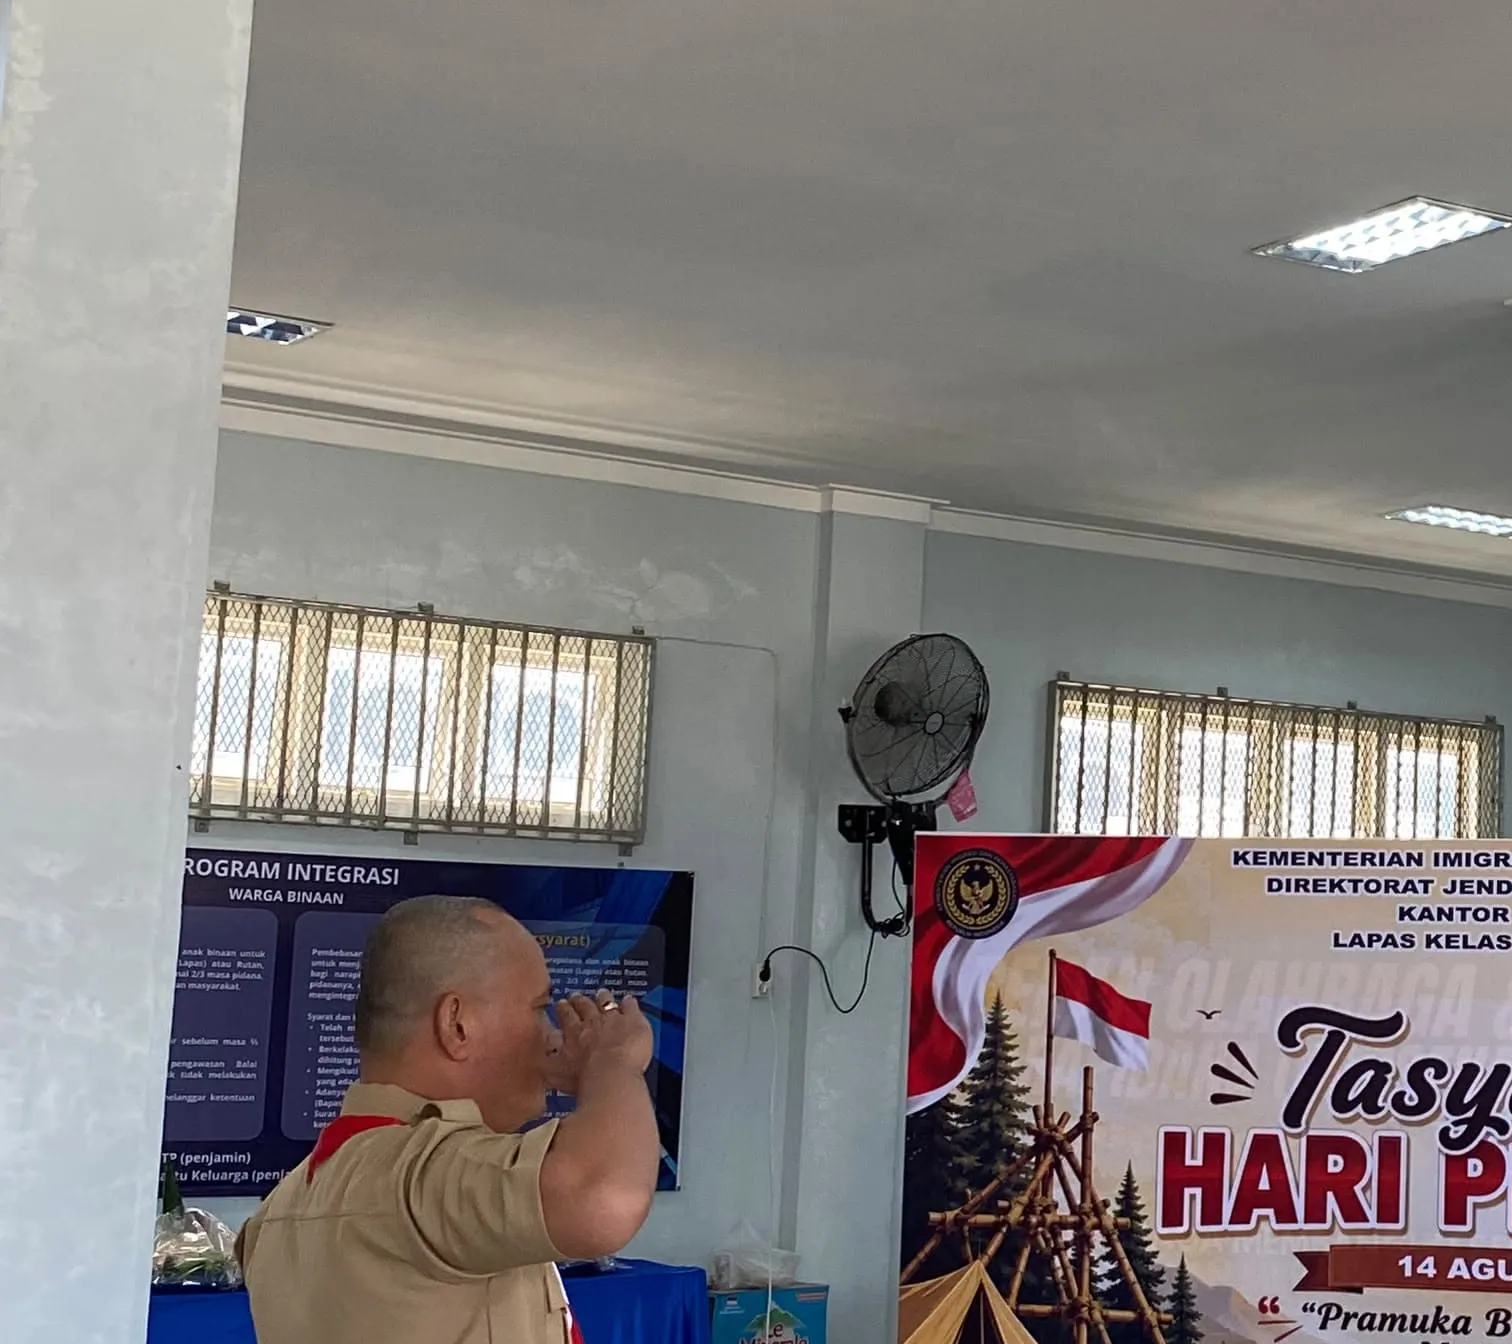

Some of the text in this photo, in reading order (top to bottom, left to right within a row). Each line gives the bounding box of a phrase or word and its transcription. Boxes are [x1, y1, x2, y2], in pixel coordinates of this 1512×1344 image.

[1233, 850, 1424, 868] KEMENTERIAN
[184, 858, 400, 885] ROGRAM INTEGRASI
[1267, 878, 1434, 894] DIREKTORAT
[228, 887, 344, 905] WARGA BINAAN
[1399, 905, 1509, 923] KANTOR
[536, 934, 590, 948] syarat)
[1333, 932, 1416, 949] LAPAS
[1425, 934, 1512, 950] KELAS
[180, 1151, 251, 1166] (penjamin)
[192, 1170, 249, 1183] Keluarga
[1160, 1129, 1401, 1229] HARI
[1398, 1255, 1437, 1278] 14
[1301, 1302, 1473, 1335] “Pramuka
